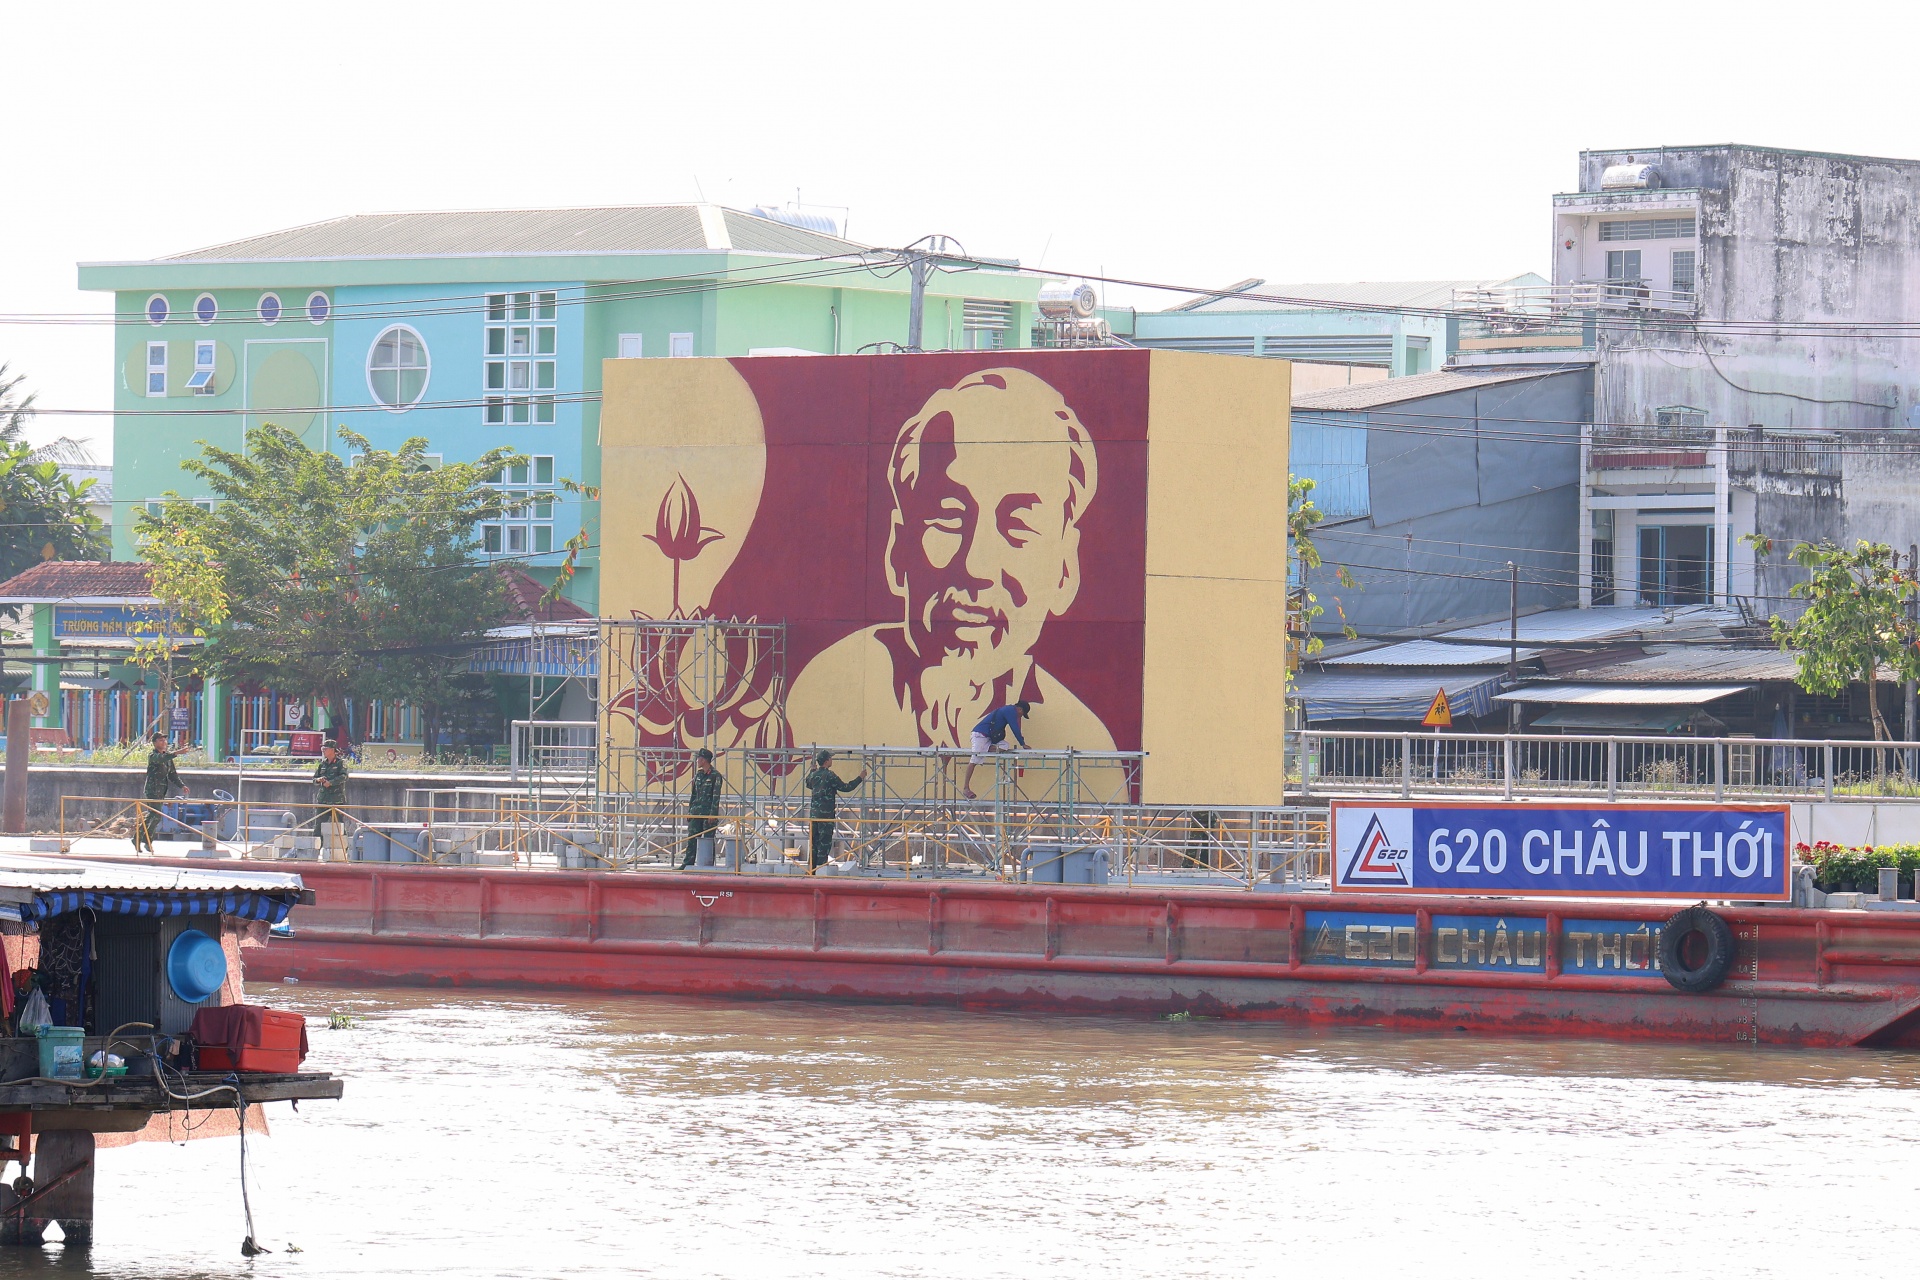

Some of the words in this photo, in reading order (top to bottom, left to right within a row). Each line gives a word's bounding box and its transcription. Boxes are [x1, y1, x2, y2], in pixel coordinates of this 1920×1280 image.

[1377, 849, 1408, 859] 620
[1428, 828, 1507, 874] 620
[1522, 818, 1648, 876] CHÂU
[1662, 820, 1773, 878] THỚI
[1345, 925, 1415, 961] 620
[1437, 918, 1541, 966] CHÂU
